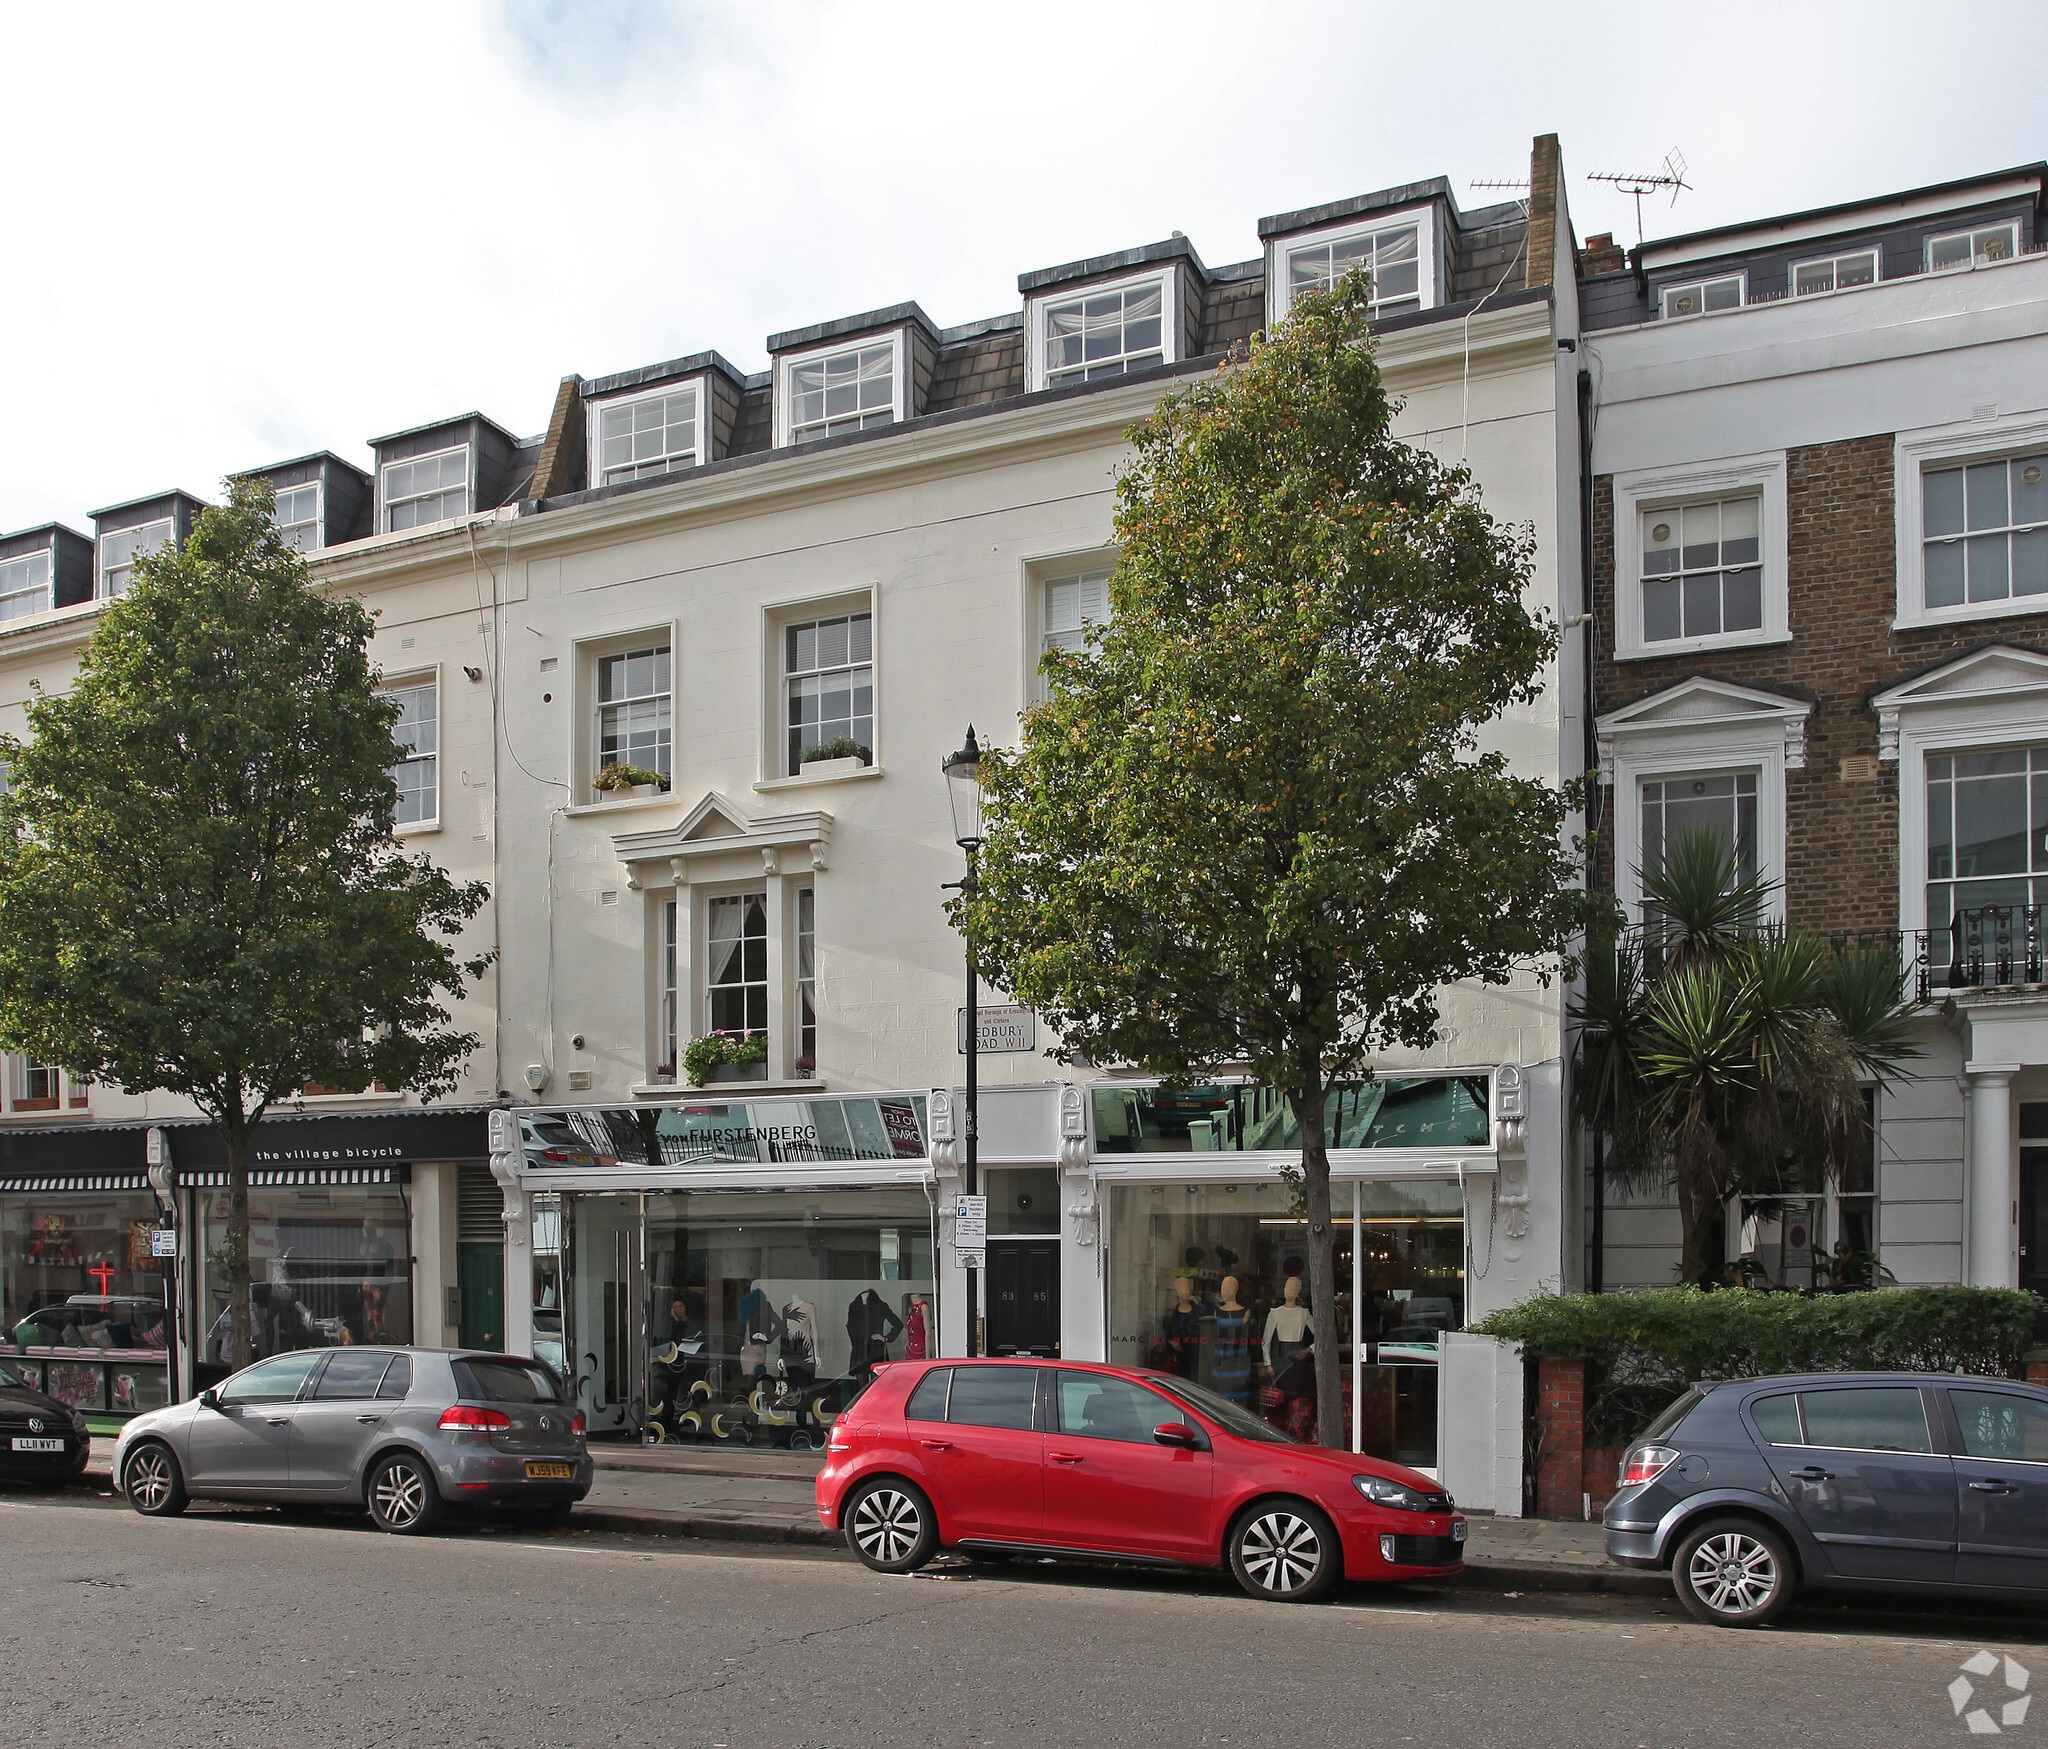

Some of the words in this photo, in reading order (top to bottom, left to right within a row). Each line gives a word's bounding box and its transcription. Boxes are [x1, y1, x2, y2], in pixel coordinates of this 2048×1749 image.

[977, 1026, 1024, 1037] EDBURY
[689, 1125, 816, 1142] FURSTENBERG
[256, 1151, 279, 1160] the
[286, 1150, 339, 1160] village
[346, 1147, 402, 1158] bicycle
[1002, 1291, 1014, 1301] 83
[1033, 1292, 1047, 1301] 85
[1112, 1335, 1145, 1343] MARC
[1172, 1336, 1207, 1344] MARC
[1213, 1337, 1267, 1345] JACOBS
[40, 1440, 57, 1449] WVT
